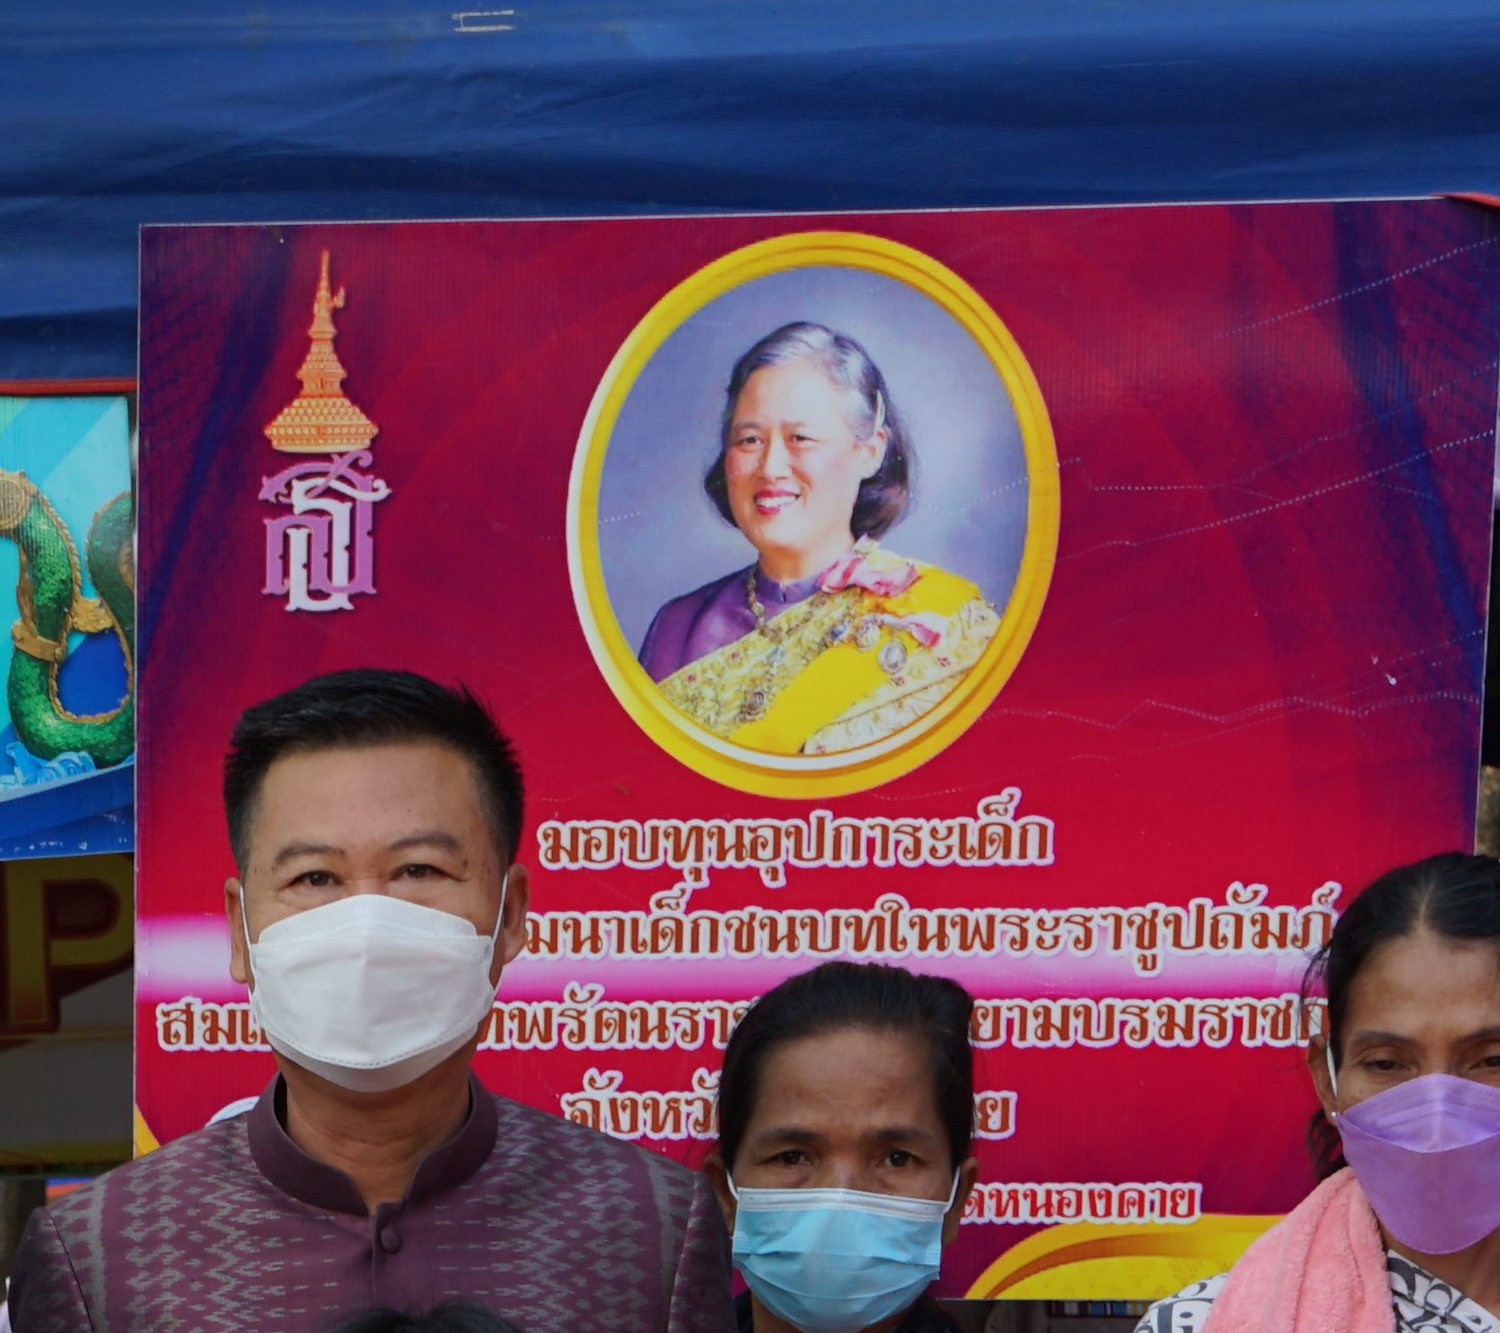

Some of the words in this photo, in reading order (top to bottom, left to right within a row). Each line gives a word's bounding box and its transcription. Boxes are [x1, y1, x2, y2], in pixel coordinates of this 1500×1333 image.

[540, 790, 1054, 887] มอบทุนอุปการะเด็ก
